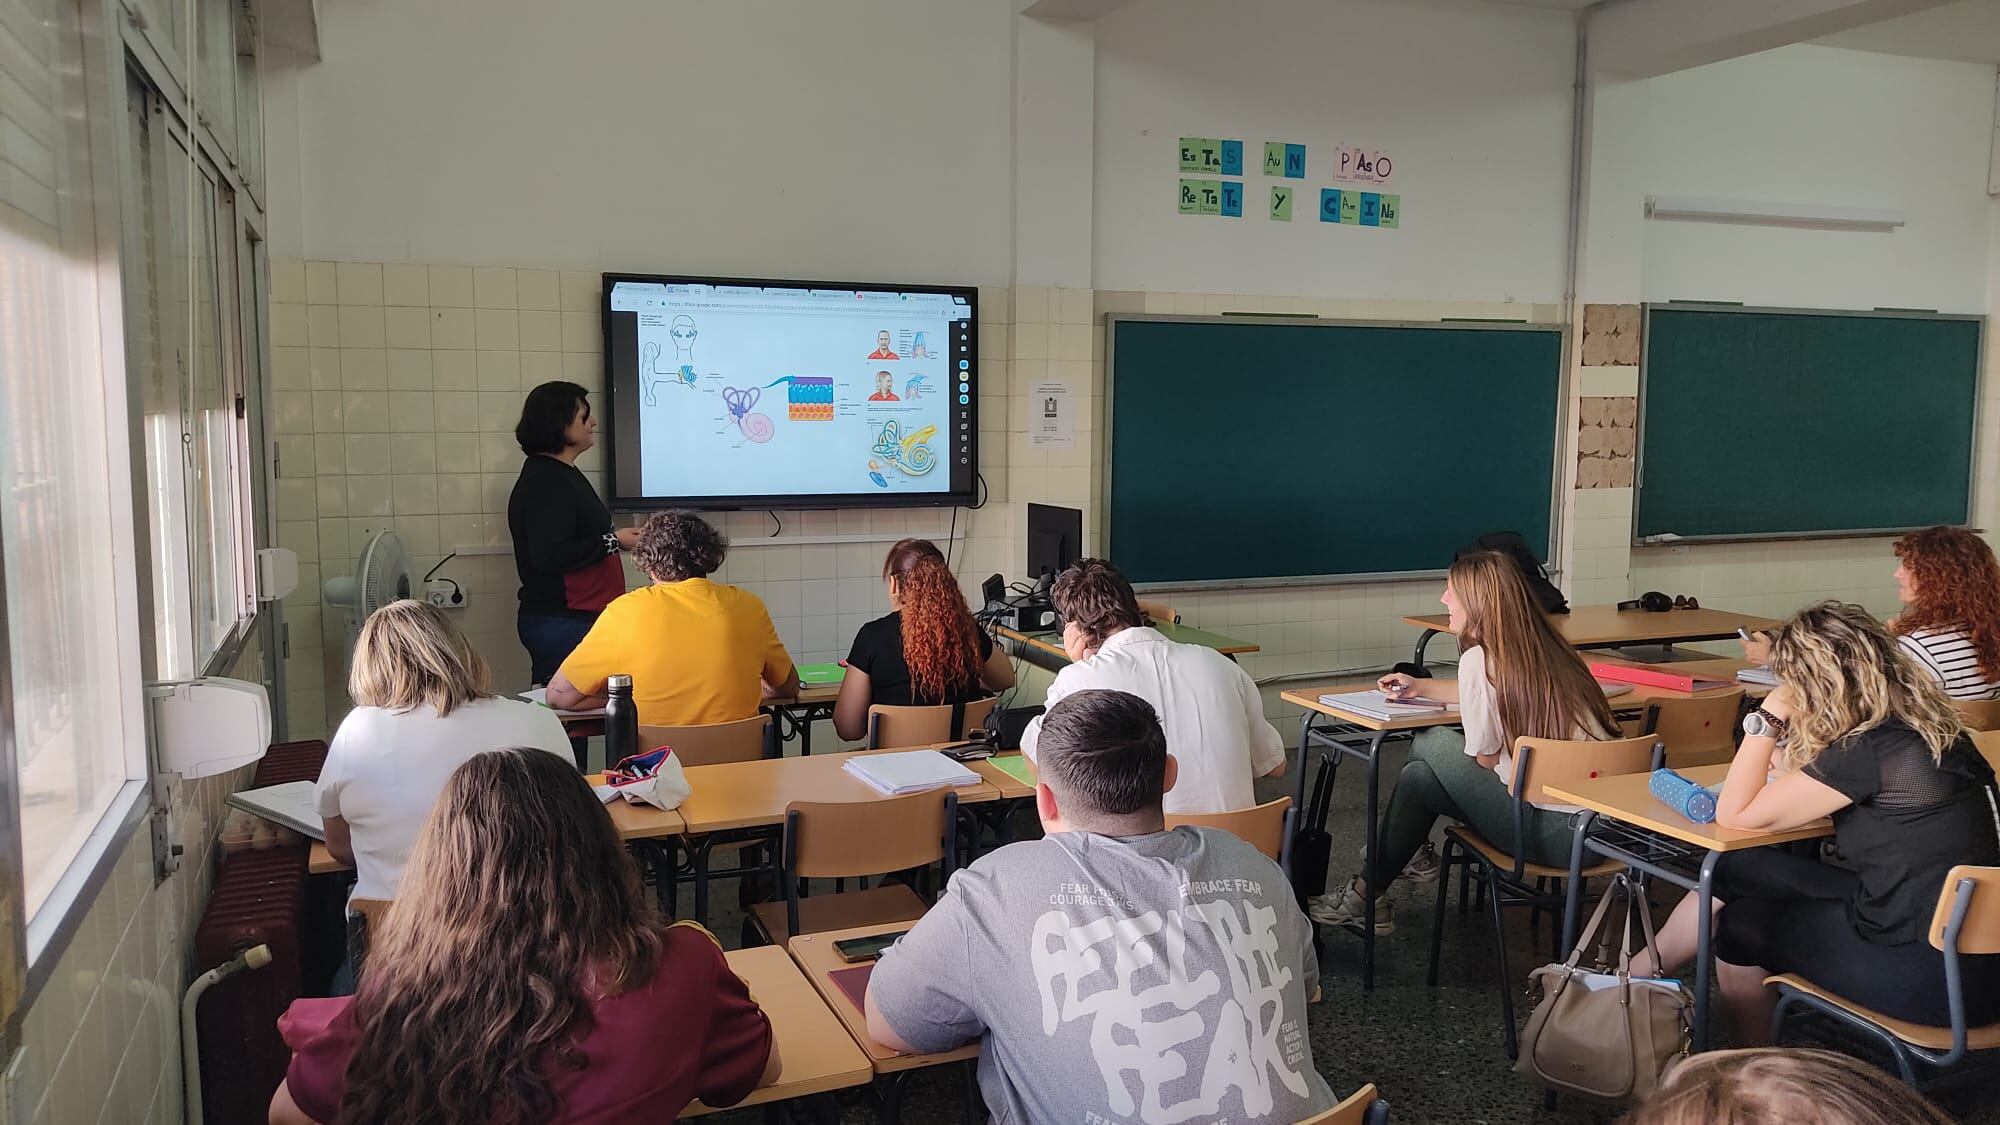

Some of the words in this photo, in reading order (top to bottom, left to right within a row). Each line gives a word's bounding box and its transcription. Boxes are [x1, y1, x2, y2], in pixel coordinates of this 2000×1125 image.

[1060, 883, 1090, 894] FEAR
[1178, 879, 1233, 898] EMBRACE
[1234, 879, 1263, 897] FEAR
[1049, 894, 1105, 906] COURAGE
